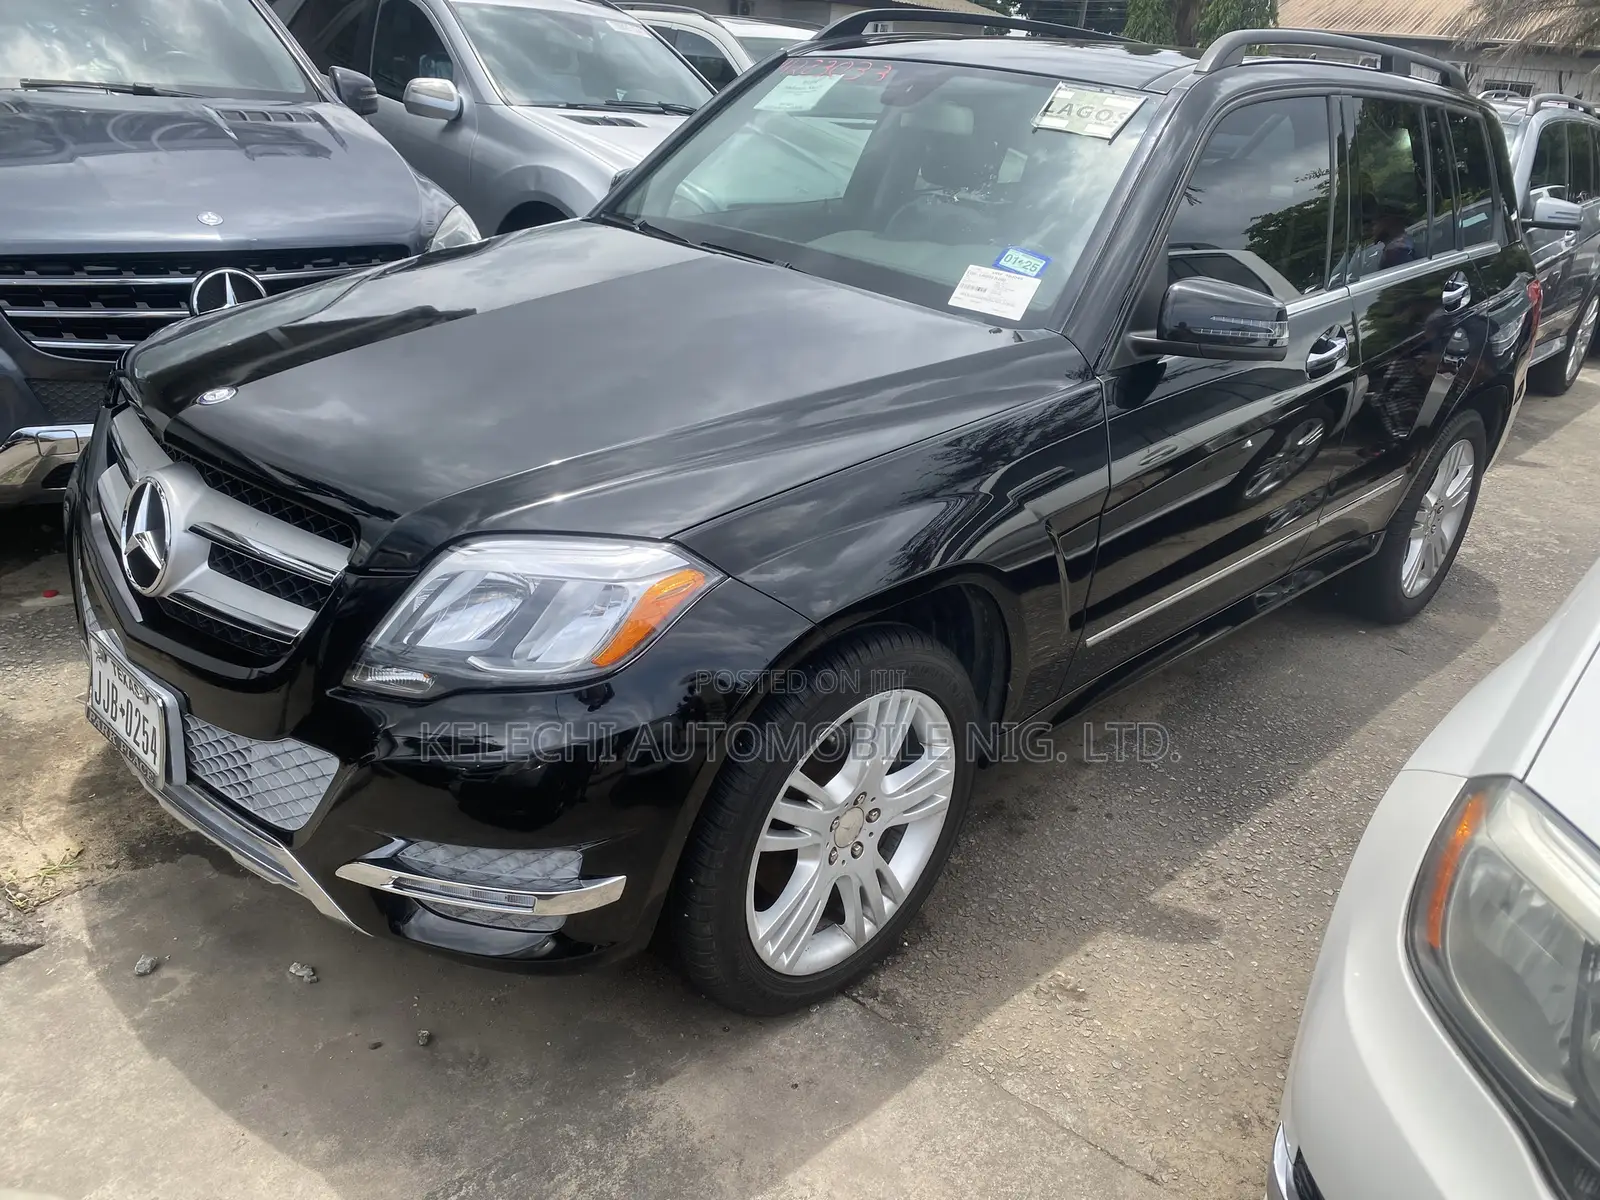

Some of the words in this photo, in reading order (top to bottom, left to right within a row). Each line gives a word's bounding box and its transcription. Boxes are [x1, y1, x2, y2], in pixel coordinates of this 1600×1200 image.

[111, 660, 143, 699] TEXAS
[88, 711, 118, 746] PARK
[120, 743, 156, 784] PLACE
